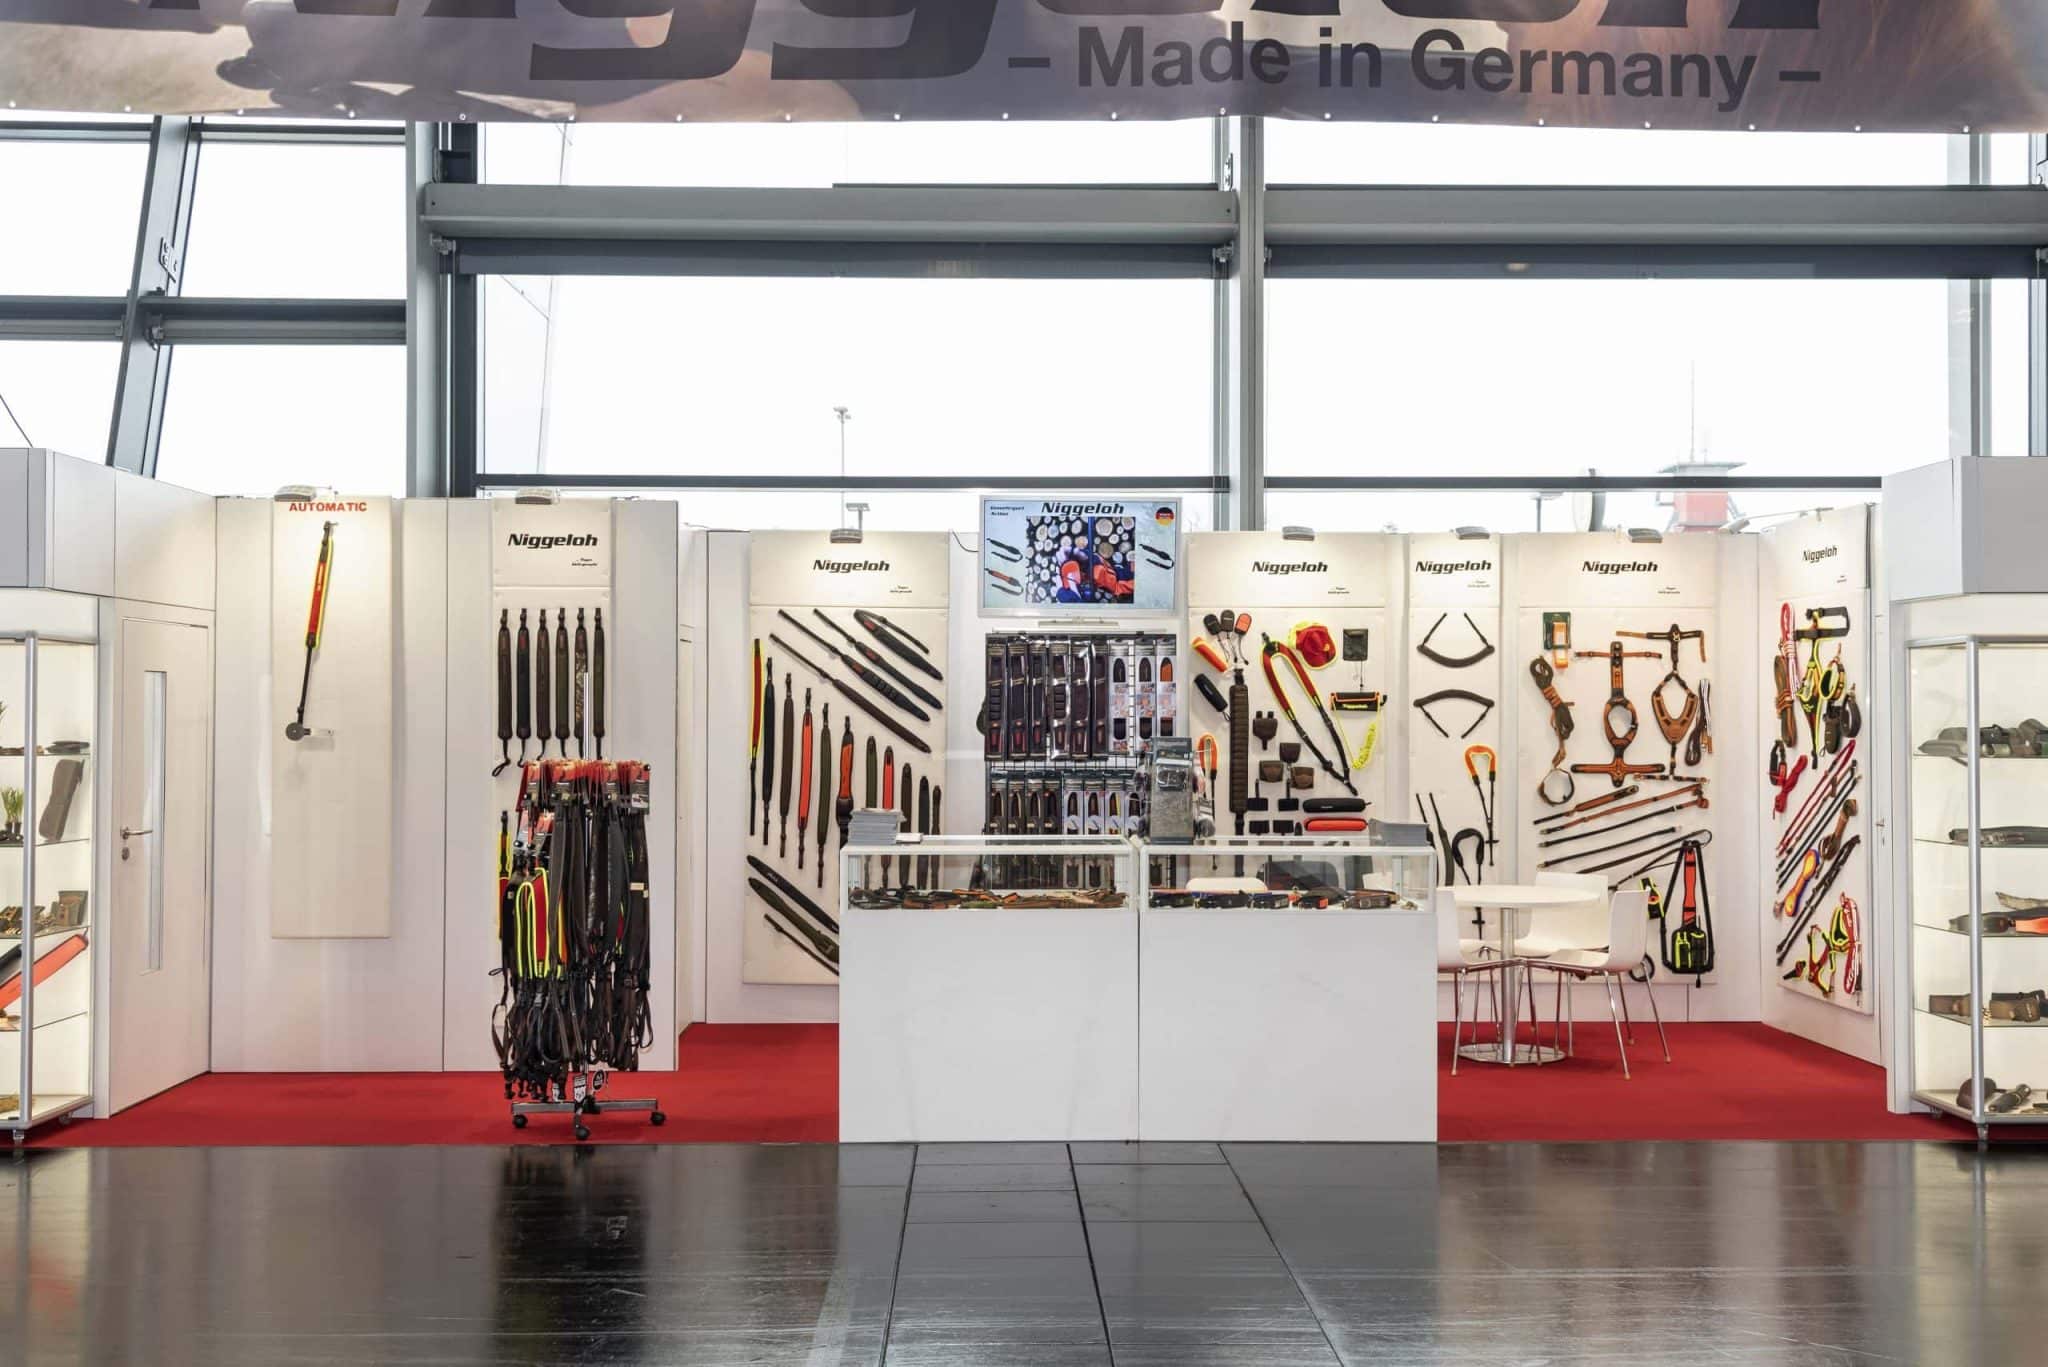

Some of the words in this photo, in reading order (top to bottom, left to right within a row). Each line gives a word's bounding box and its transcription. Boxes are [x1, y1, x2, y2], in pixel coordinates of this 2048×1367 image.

[1078, 21, 1291, 88] Made
[1318, 26, 1382, 88] in
[1410, 28, 1758, 113] Germany
[289, 501, 368, 512] AUTOMATIC
[1042, 502, 1124, 516] Niggeloh
[508, 534, 598, 548] Niggeloh
[1802, 546, 1837, 563] Niggeloh
[813, 560, 889, 573] Niggeloh
[1252, 561, 1328, 574] Niggeloh
[1415, 560, 1491, 574] Niggeloh
[1582, 561, 1658, 574] Niggeloh
